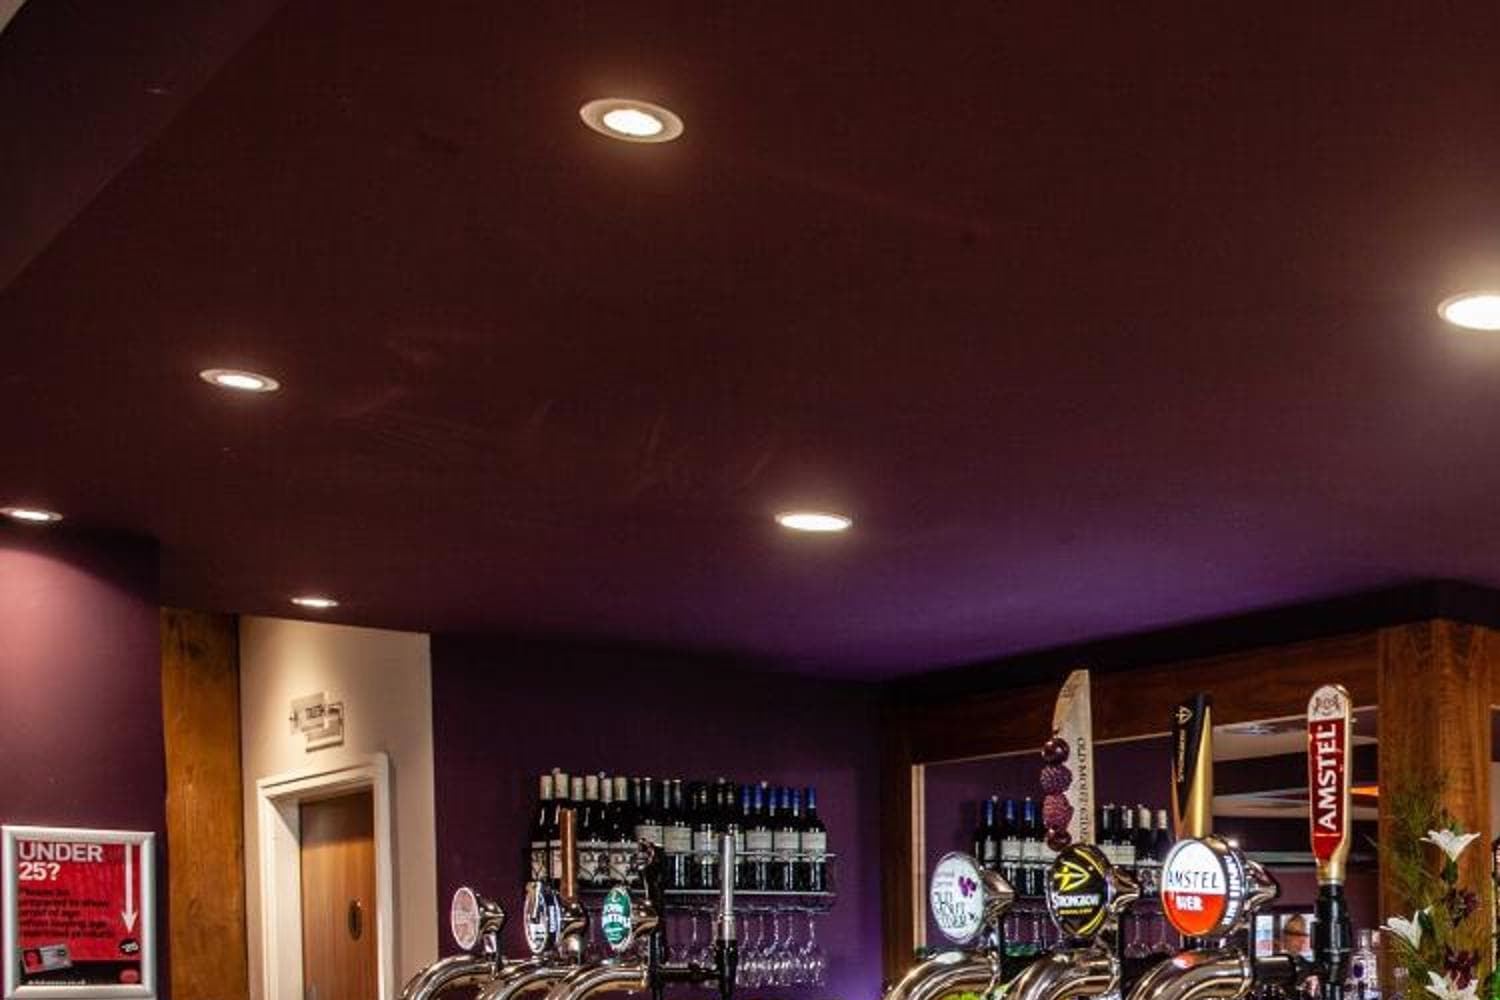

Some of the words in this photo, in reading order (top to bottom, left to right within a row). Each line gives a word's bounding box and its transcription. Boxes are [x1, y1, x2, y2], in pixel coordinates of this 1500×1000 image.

[1316, 723, 1337, 832] AMSTEL
[20, 841, 103, 862] UNDER
[19, 861, 60, 881] 25?
[1168, 871, 1220, 889] AMSTEL
